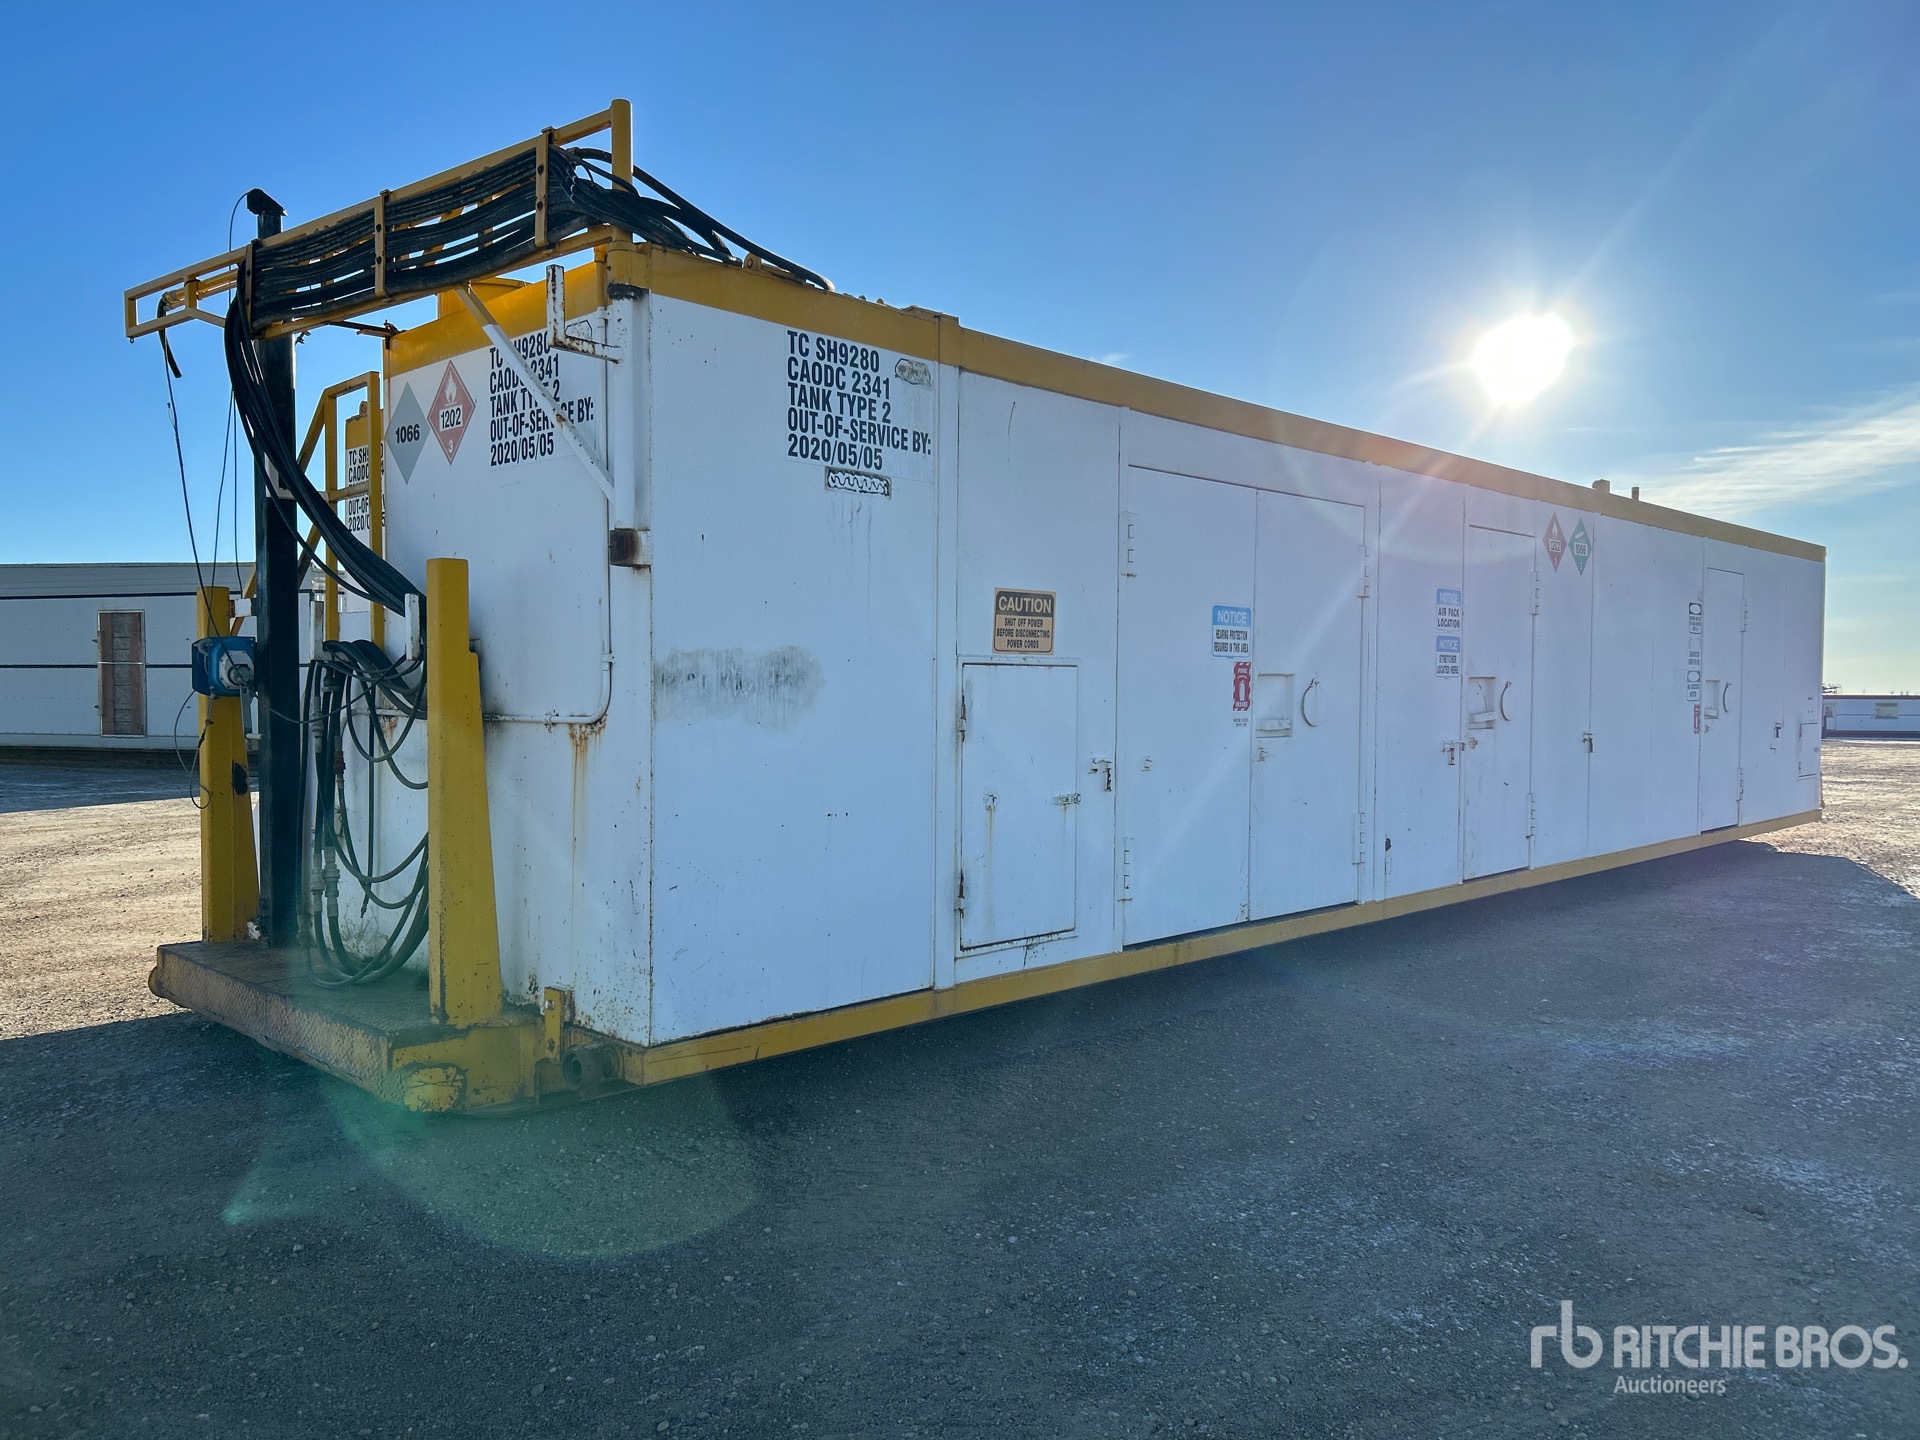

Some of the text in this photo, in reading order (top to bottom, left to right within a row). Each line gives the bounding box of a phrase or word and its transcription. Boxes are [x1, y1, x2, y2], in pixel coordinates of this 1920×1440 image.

[514, 331, 550, 360] H9280
[787, 330, 880, 372] TC SH9280
[788, 357, 890, 400] CAODC 2341
[490, 391, 518, 418] TANK
[553, 380, 560, 402] 2
[788, 382, 891, 424] TANK TYPE 2
[441, 407, 462, 429] 1202
[490, 396, 594, 442] OUT-OF-SERE BY:
[396, 424, 420, 444] 1066
[788, 408, 931, 454] OUT-OF-SERVICE BY:
[448, 440, 454, 453] 3
[490, 432, 554, 466] 2020/05/05
[788, 434, 882, 470] 2020/05/05
[349, 450, 357, 467] TC
[998, 596, 1052, 613] CAUTION
[1438, 607, 1460, 617] AIR PACK
[1005, 618, 1043, 628] SHUT OFF POWER
[1217, 610, 1247, 624] NOTICE
[1438, 618, 1460, 628] LOCATION
[997, 628, 1050, 638] BEFORE DISCONNECTING
[1007, 640, 1039, 649] POWER CORDS
[1439, 639, 1458, 651] NOTICE
